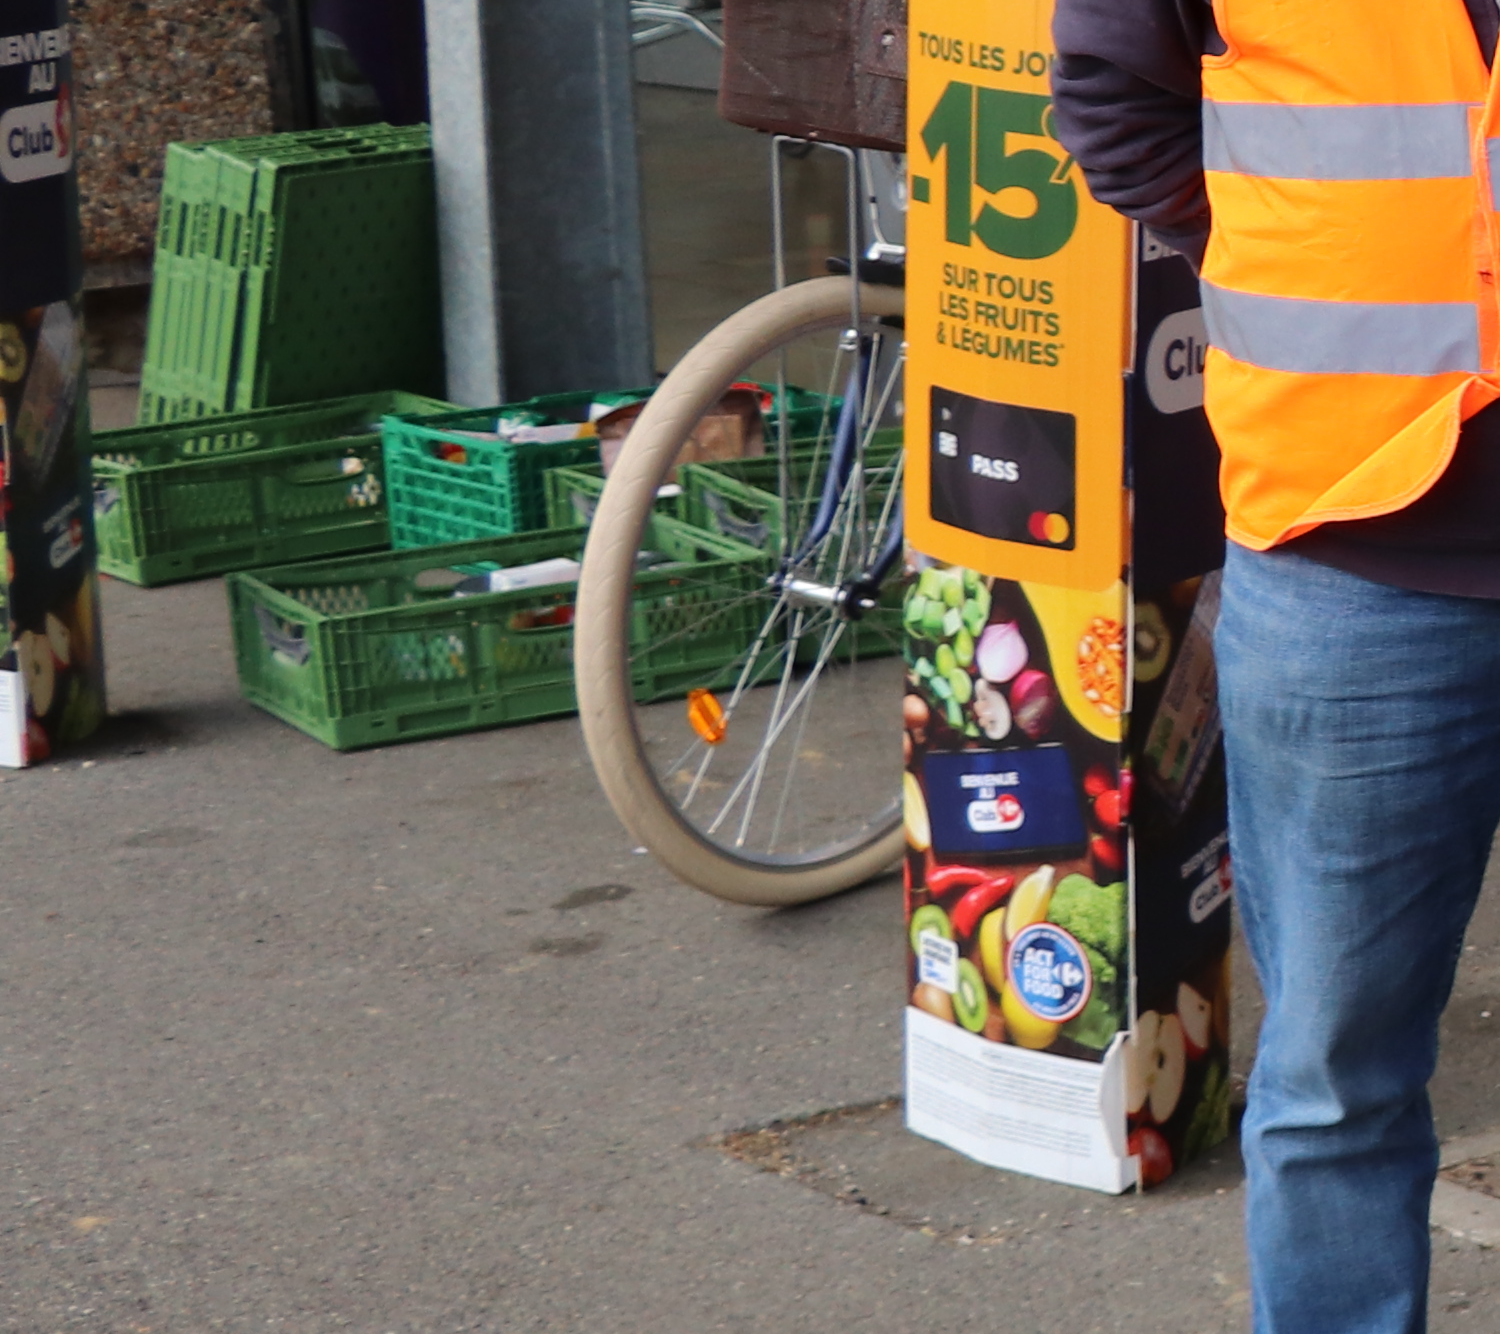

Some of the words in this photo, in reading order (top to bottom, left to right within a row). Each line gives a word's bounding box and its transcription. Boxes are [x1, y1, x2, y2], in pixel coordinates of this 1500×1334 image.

[918, 30, 963, 66] TOUS
[969, 42, 1005, 72] LES
[1013, 50, 1058, 77] JO
[28, 62, 56, 94] AU
[7, 121, 54, 158] Club
[942, 262, 978, 294] SUR
[985, 271, 1054, 306] TOUS
[939, 290, 968, 321] LES
[975, 301, 1061, 337] FRUITS
[936, 321, 946, 345] &
[970, 454, 1020, 483] PASS
